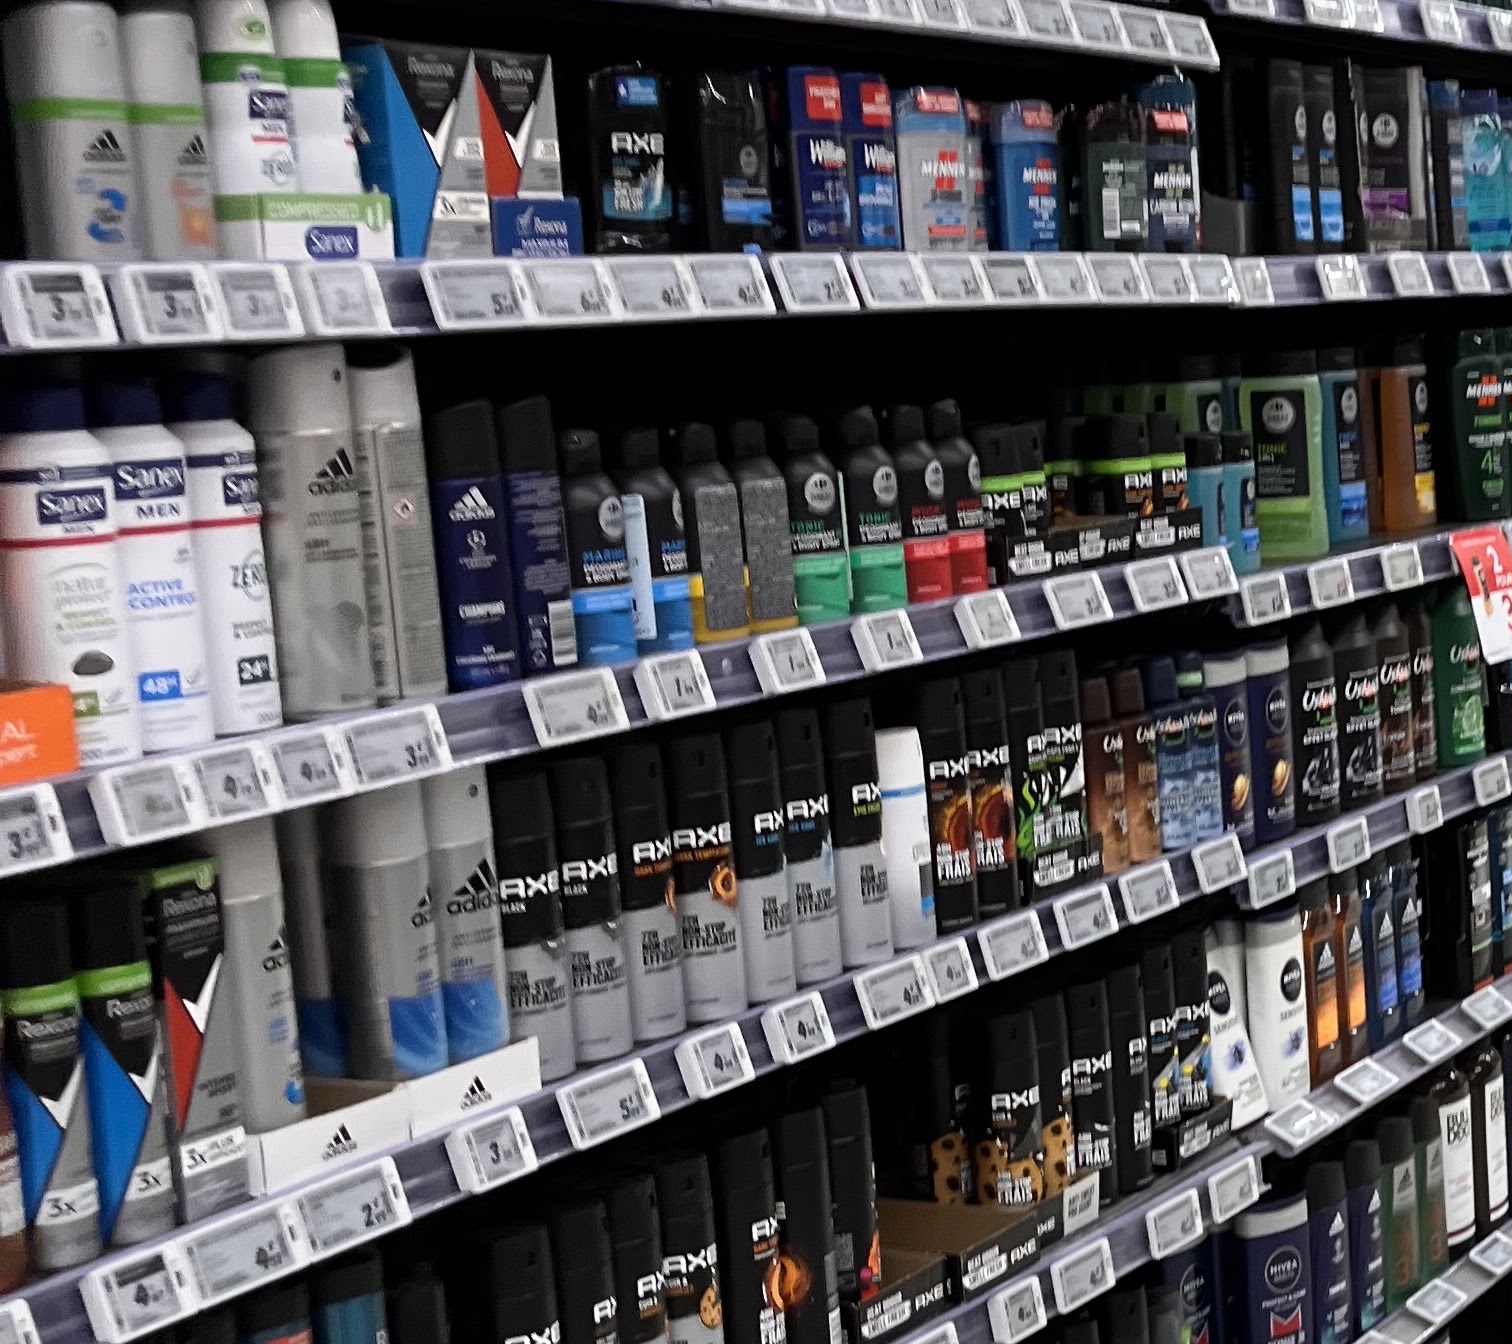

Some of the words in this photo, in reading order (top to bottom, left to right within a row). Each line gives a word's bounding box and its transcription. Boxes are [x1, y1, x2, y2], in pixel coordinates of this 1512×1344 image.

[611, 131, 665, 155] AXE
[307, 226, 354, 255] Sanex
[112, 462, 185, 493] Sanex
[40, 493, 105, 516] Sanex
[136, 503, 181, 519] MEN
[1485, 544, 1504, 575] 2
[128, 578, 186, 597] ACTIVE
[673, 821, 732, 851] AXE
[561, 851, 618, 882] AXE
[499, 869, 560, 902] AXE
[991, 1083, 1040, 1111] AXE
[662, 1242, 717, 1277] AXE
